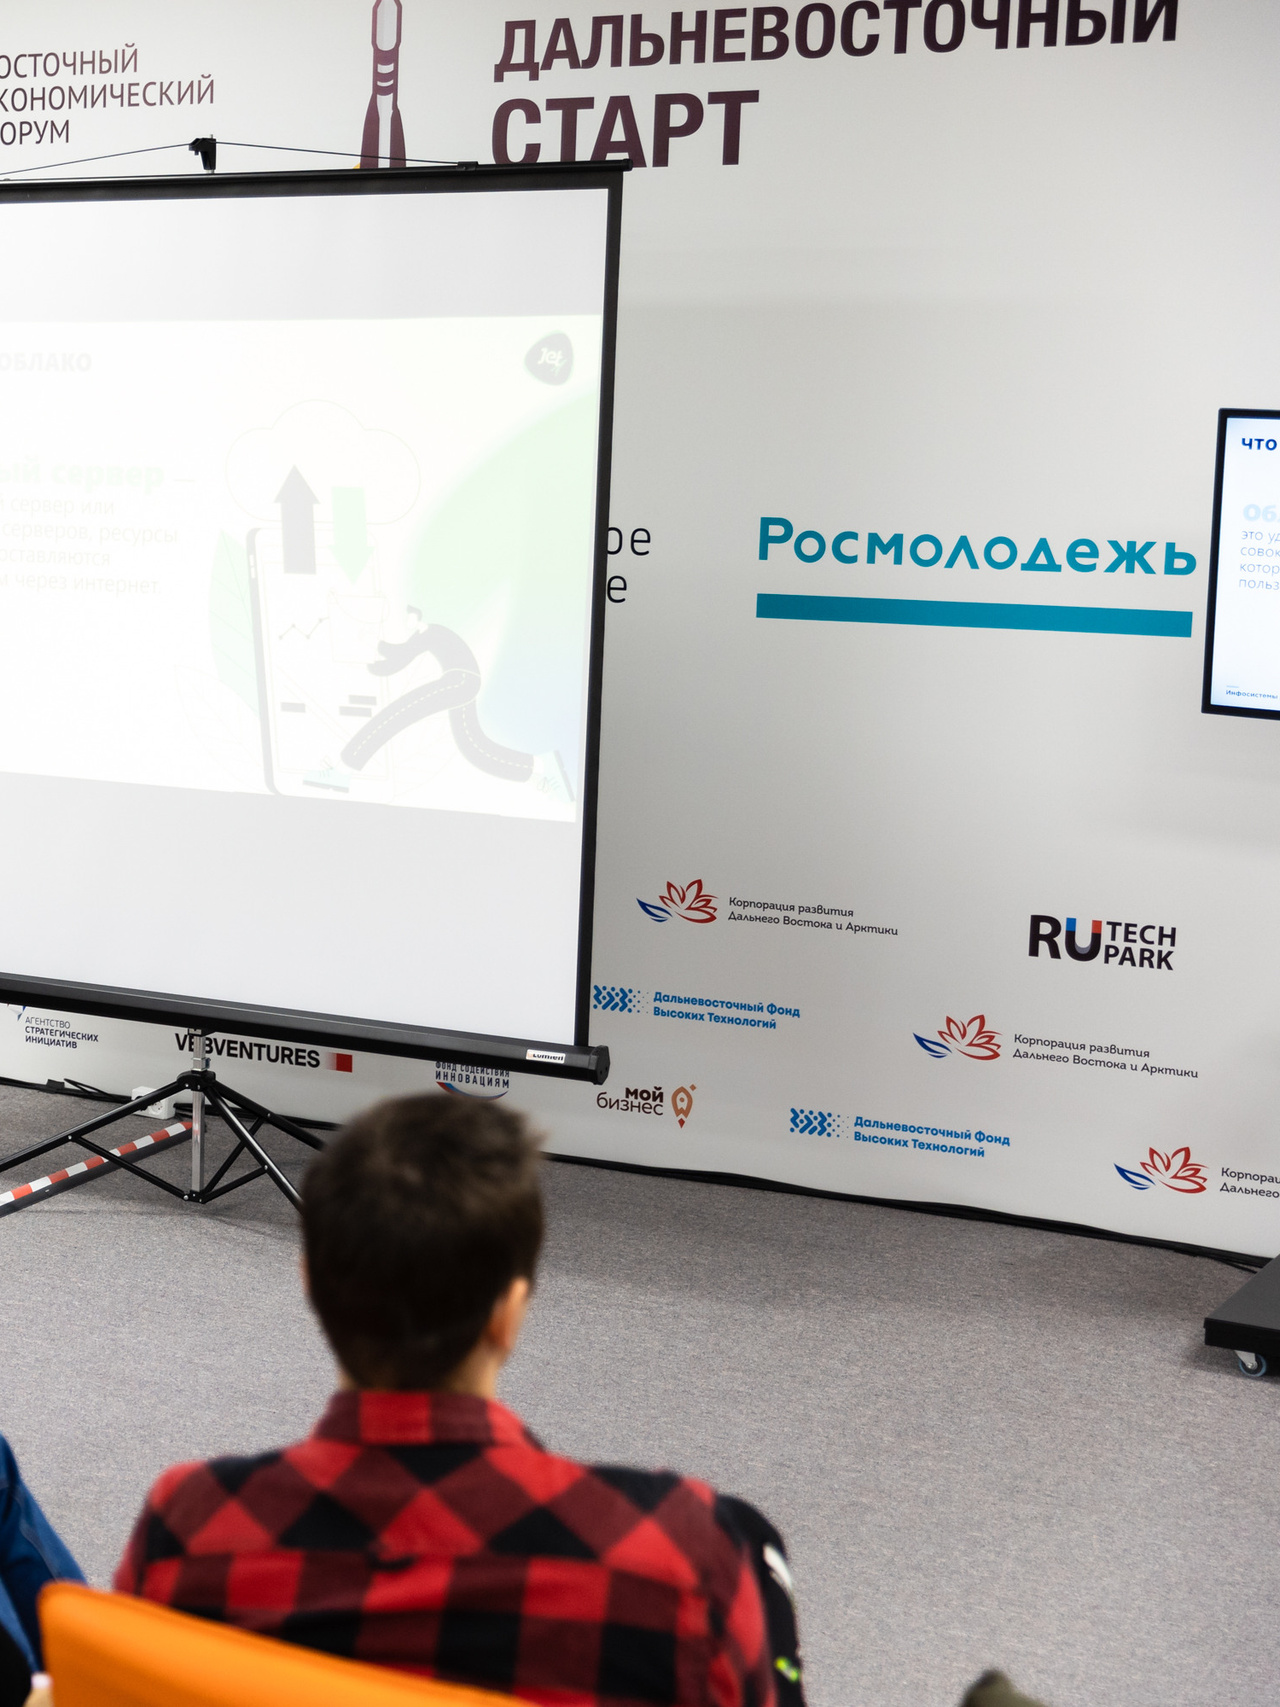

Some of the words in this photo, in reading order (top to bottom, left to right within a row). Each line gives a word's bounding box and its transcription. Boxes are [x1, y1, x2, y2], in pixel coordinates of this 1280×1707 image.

[492, 90, 760, 168] СТАРТ
[1241, 437, 1278, 451] ЧТО
[50, 464, 166, 496] сервер
[1242, 503, 1280, 523] Об
[758, 516, 1198, 577] Росмолодежь
[1240, 530, 1264, 541] это
[728, 896, 795, 914] Корпорация
[797, 903, 854, 919] развития
[727, 911, 780, 925] Дальнего
[782, 915, 833, 930] Востока
[835, 922, 843, 931] и
[845, 922, 899, 936] Арктики
[1106, 920, 1177, 947] TECH
[1027, 914, 1103, 962] RU
[1103, 944, 1174, 971] PARK
[653, 991, 765, 1013] Дальневосточный
[766, 1002, 801, 1018] Фонд
[25, 1016, 71, 1029] АГЕНТСТВО
[653, 1006, 705, 1021] Высоких
[707, 1010, 777, 1029] Технологий
[24, 1025, 99, 1042] СТРАТЕГИЧЕСКИХ
[25, 1036, 78, 1049] ИНИЦИАТИВ
[1013, 1033, 1086, 1051] Корпорация
[1089, 1043, 1151, 1058] развития
[1012, 1048, 1070, 1064] Дальнего
[1072, 1054, 1127, 1070] Востока
[1130, 1063, 1138, 1071] и
[1140, 1062, 1199, 1079] Арктики
[435, 1070, 510, 1089] ИННОВАЦИЯМ
[596, 1091, 664, 1116] бизнес
[625, 1085, 664, 1103] мой
[853, 1115, 972, 1140] Дальневосточный
[974, 1129, 1011, 1147] Фонд
[853, 1131, 909, 1148] Высоких
[911, 1138, 986, 1158] Технологий
[1219, 1182, 1280, 1199] Дальнего
